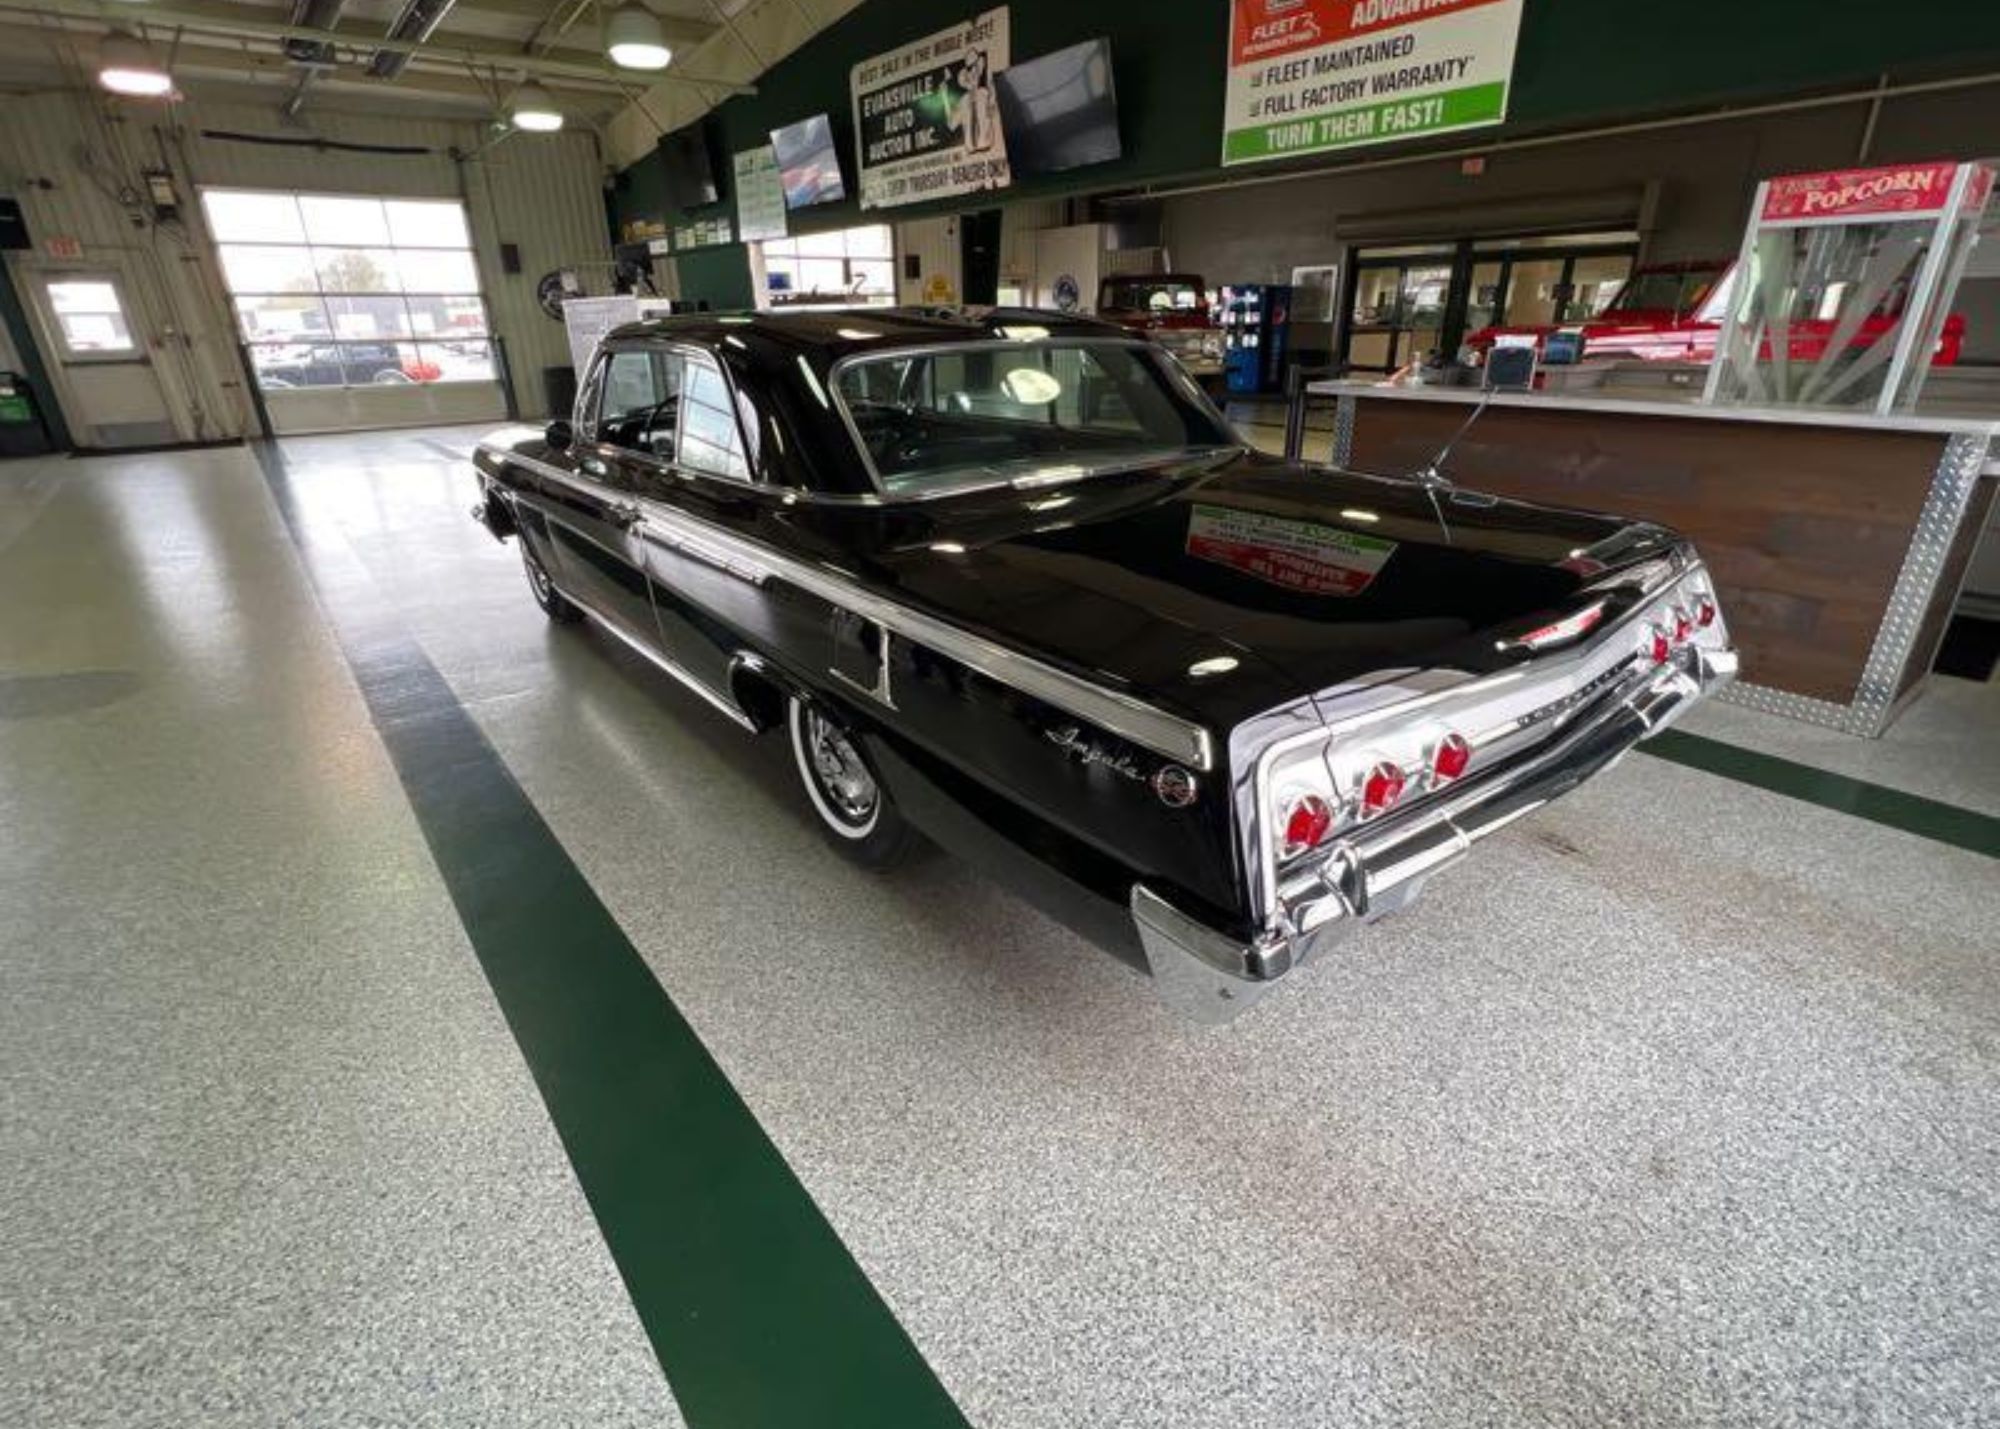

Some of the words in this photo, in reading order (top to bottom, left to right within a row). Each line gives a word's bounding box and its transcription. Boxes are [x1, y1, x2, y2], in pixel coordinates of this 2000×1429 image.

[1266, 57, 1310, 86] FLEET
[1312, 34, 1415, 76] MAINTAINED
[1264, 94, 1296, 116] FULL
[1301, 80, 1366, 110] FACTORY
[1266, 121, 1314, 150] TURN
[1320, 112, 1374, 142] THEM
[1381, 99, 1444, 133] FAST!
[1801, 169, 1937, 213] POPCORN
